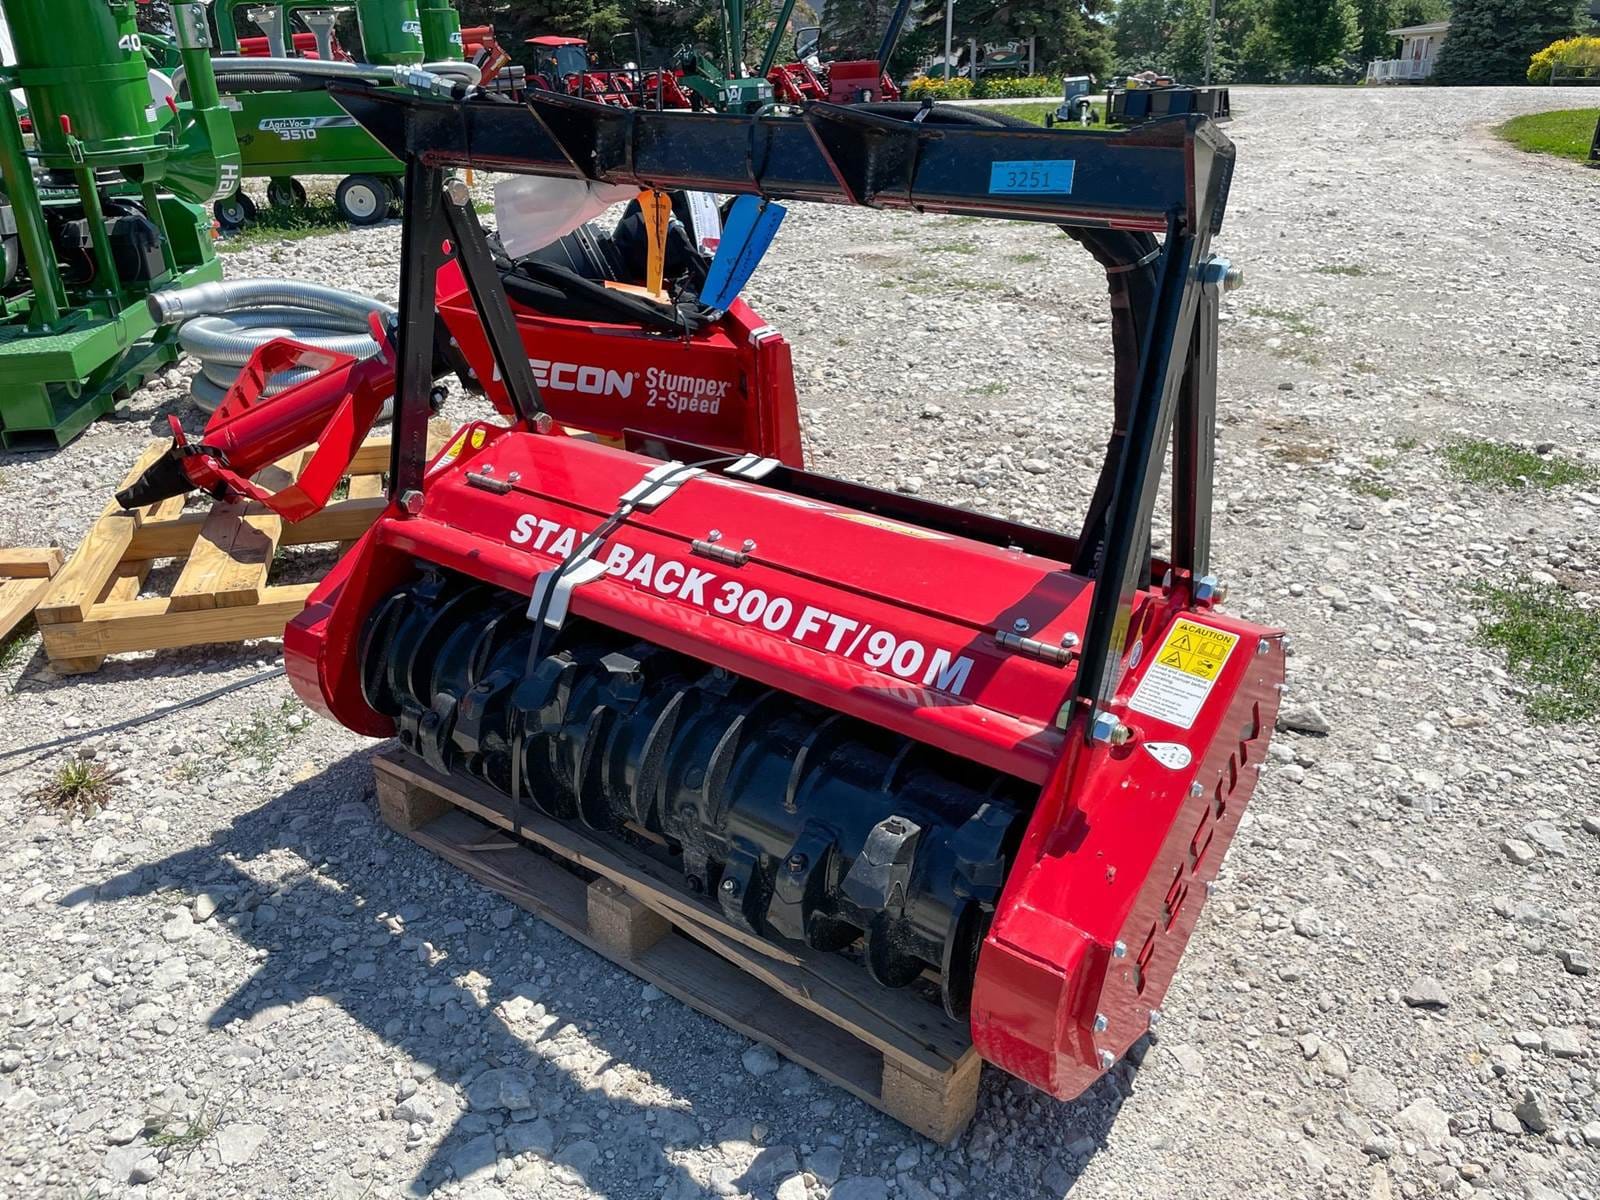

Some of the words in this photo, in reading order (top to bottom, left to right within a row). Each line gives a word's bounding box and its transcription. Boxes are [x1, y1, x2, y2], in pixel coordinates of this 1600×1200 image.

[280, 129, 317, 141] 3510
[1007, 171, 1050, 188] 3251
[645, 367, 728, 397] Stumpex
[647, 389, 720, 414] 2-Speed
[606, 543, 717, 606] BACK
[713, 581, 793, 631] 300
[1187, 623, 1233, 643] CAUTION
